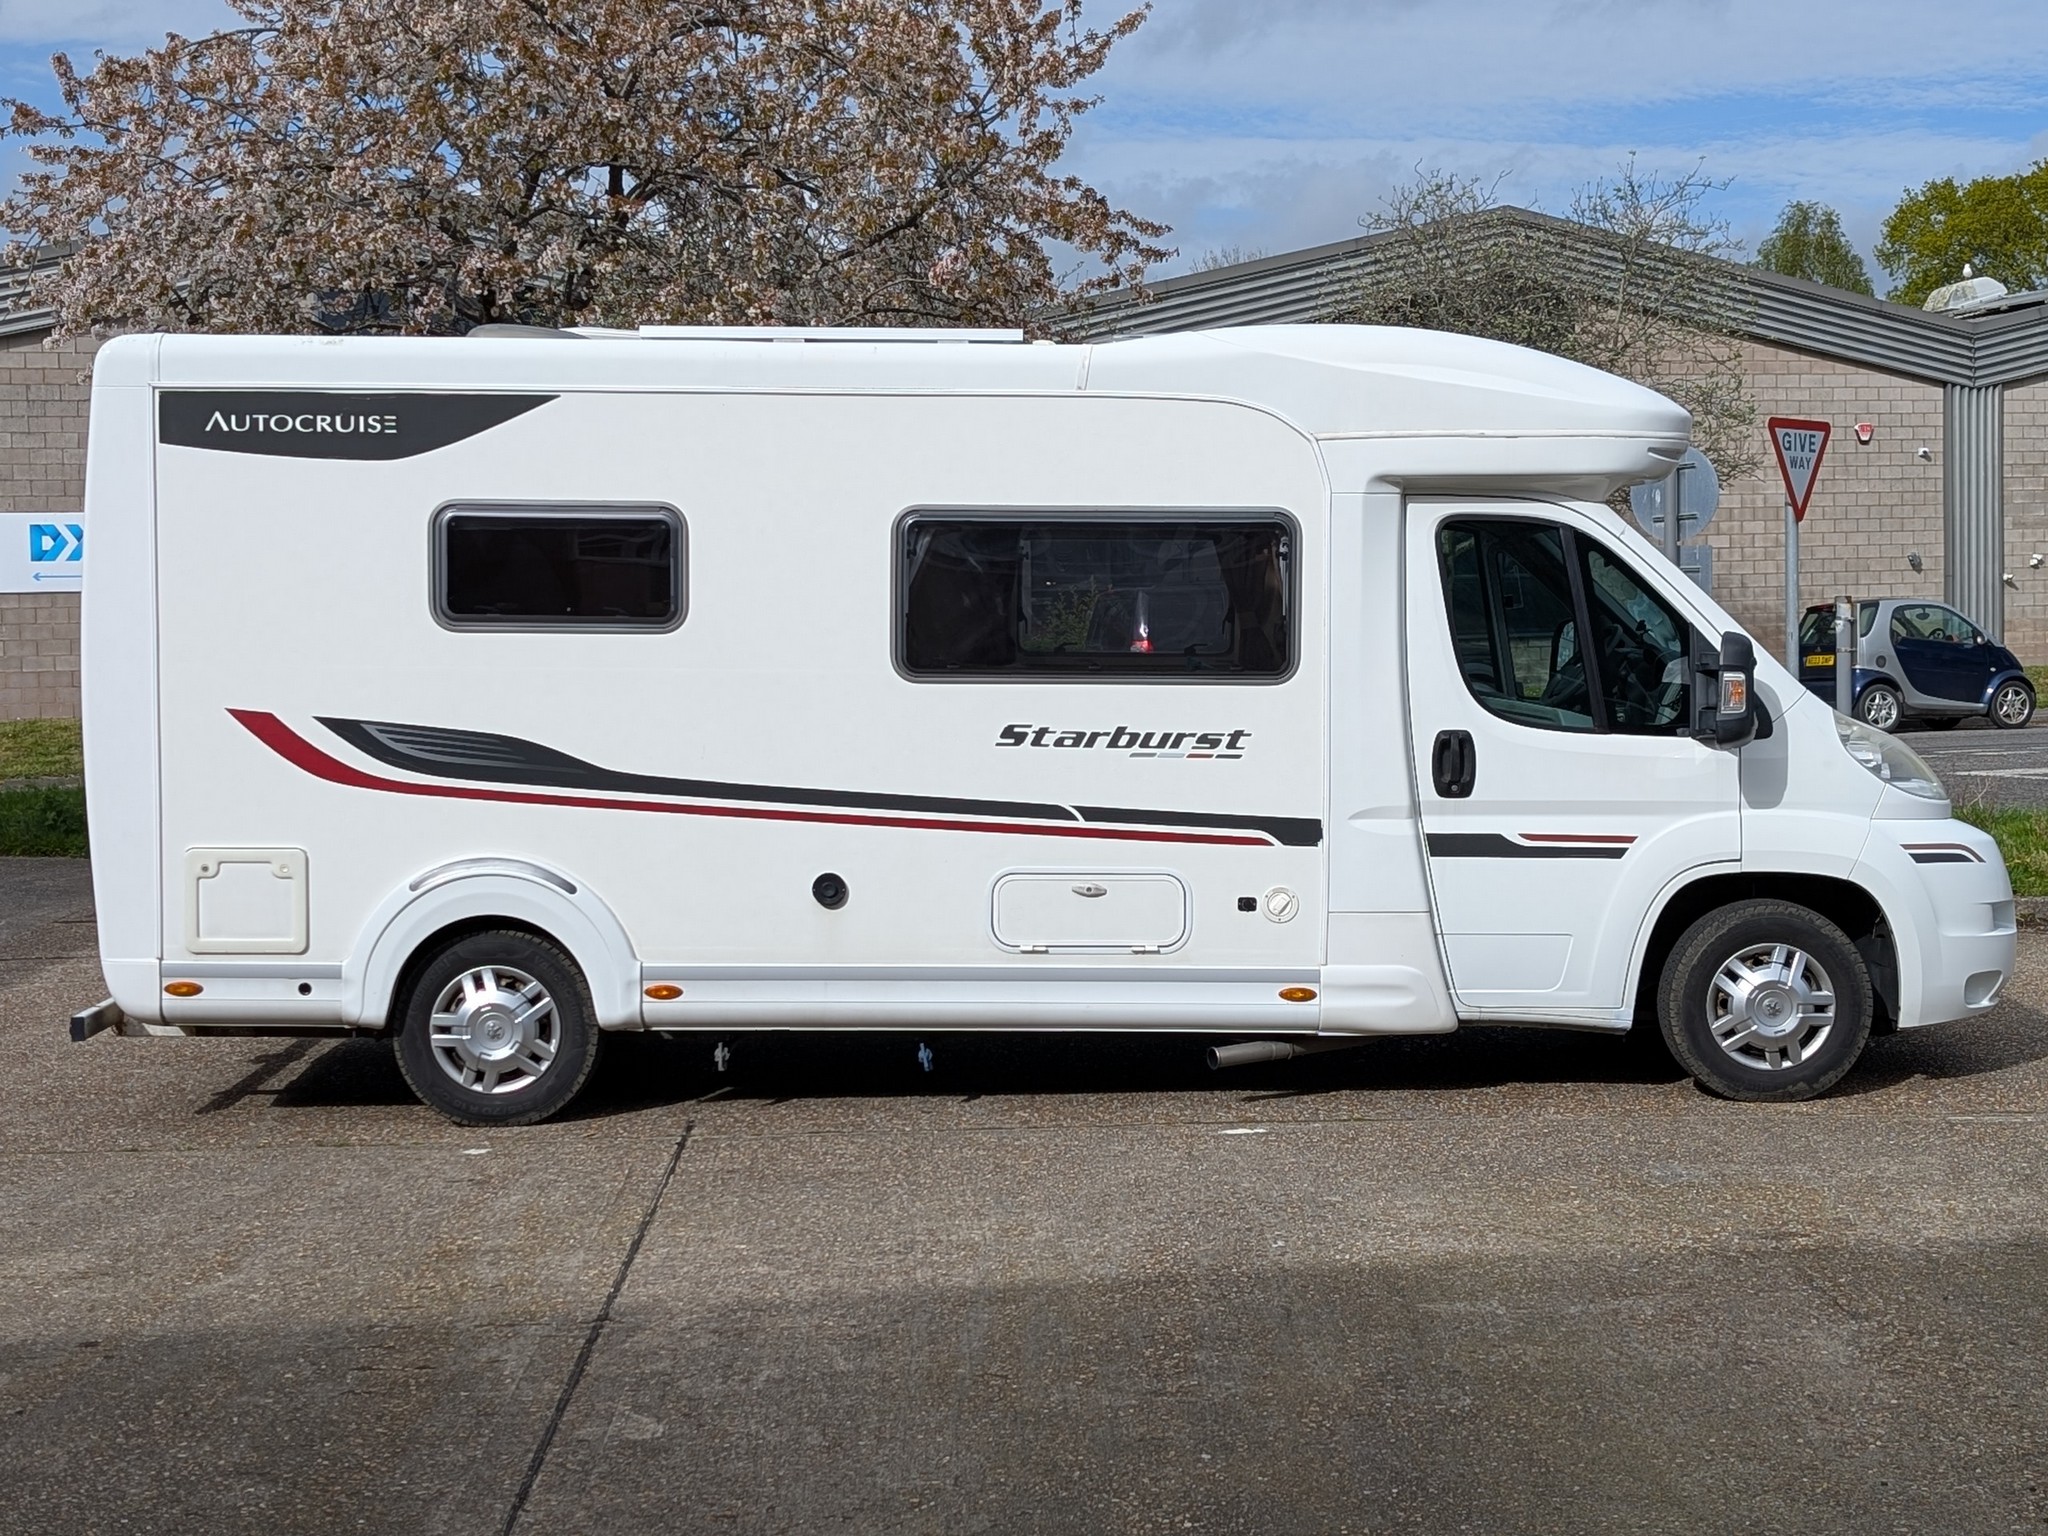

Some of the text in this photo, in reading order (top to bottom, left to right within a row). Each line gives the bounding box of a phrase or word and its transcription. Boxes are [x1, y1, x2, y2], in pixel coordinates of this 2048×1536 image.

[205, 411, 397, 433] AUTOCRUISE
[1782, 432, 1816, 453] GIVE
[1789, 455, 1812, 470] WAY
[995, 724, 1252, 750] Starburst
